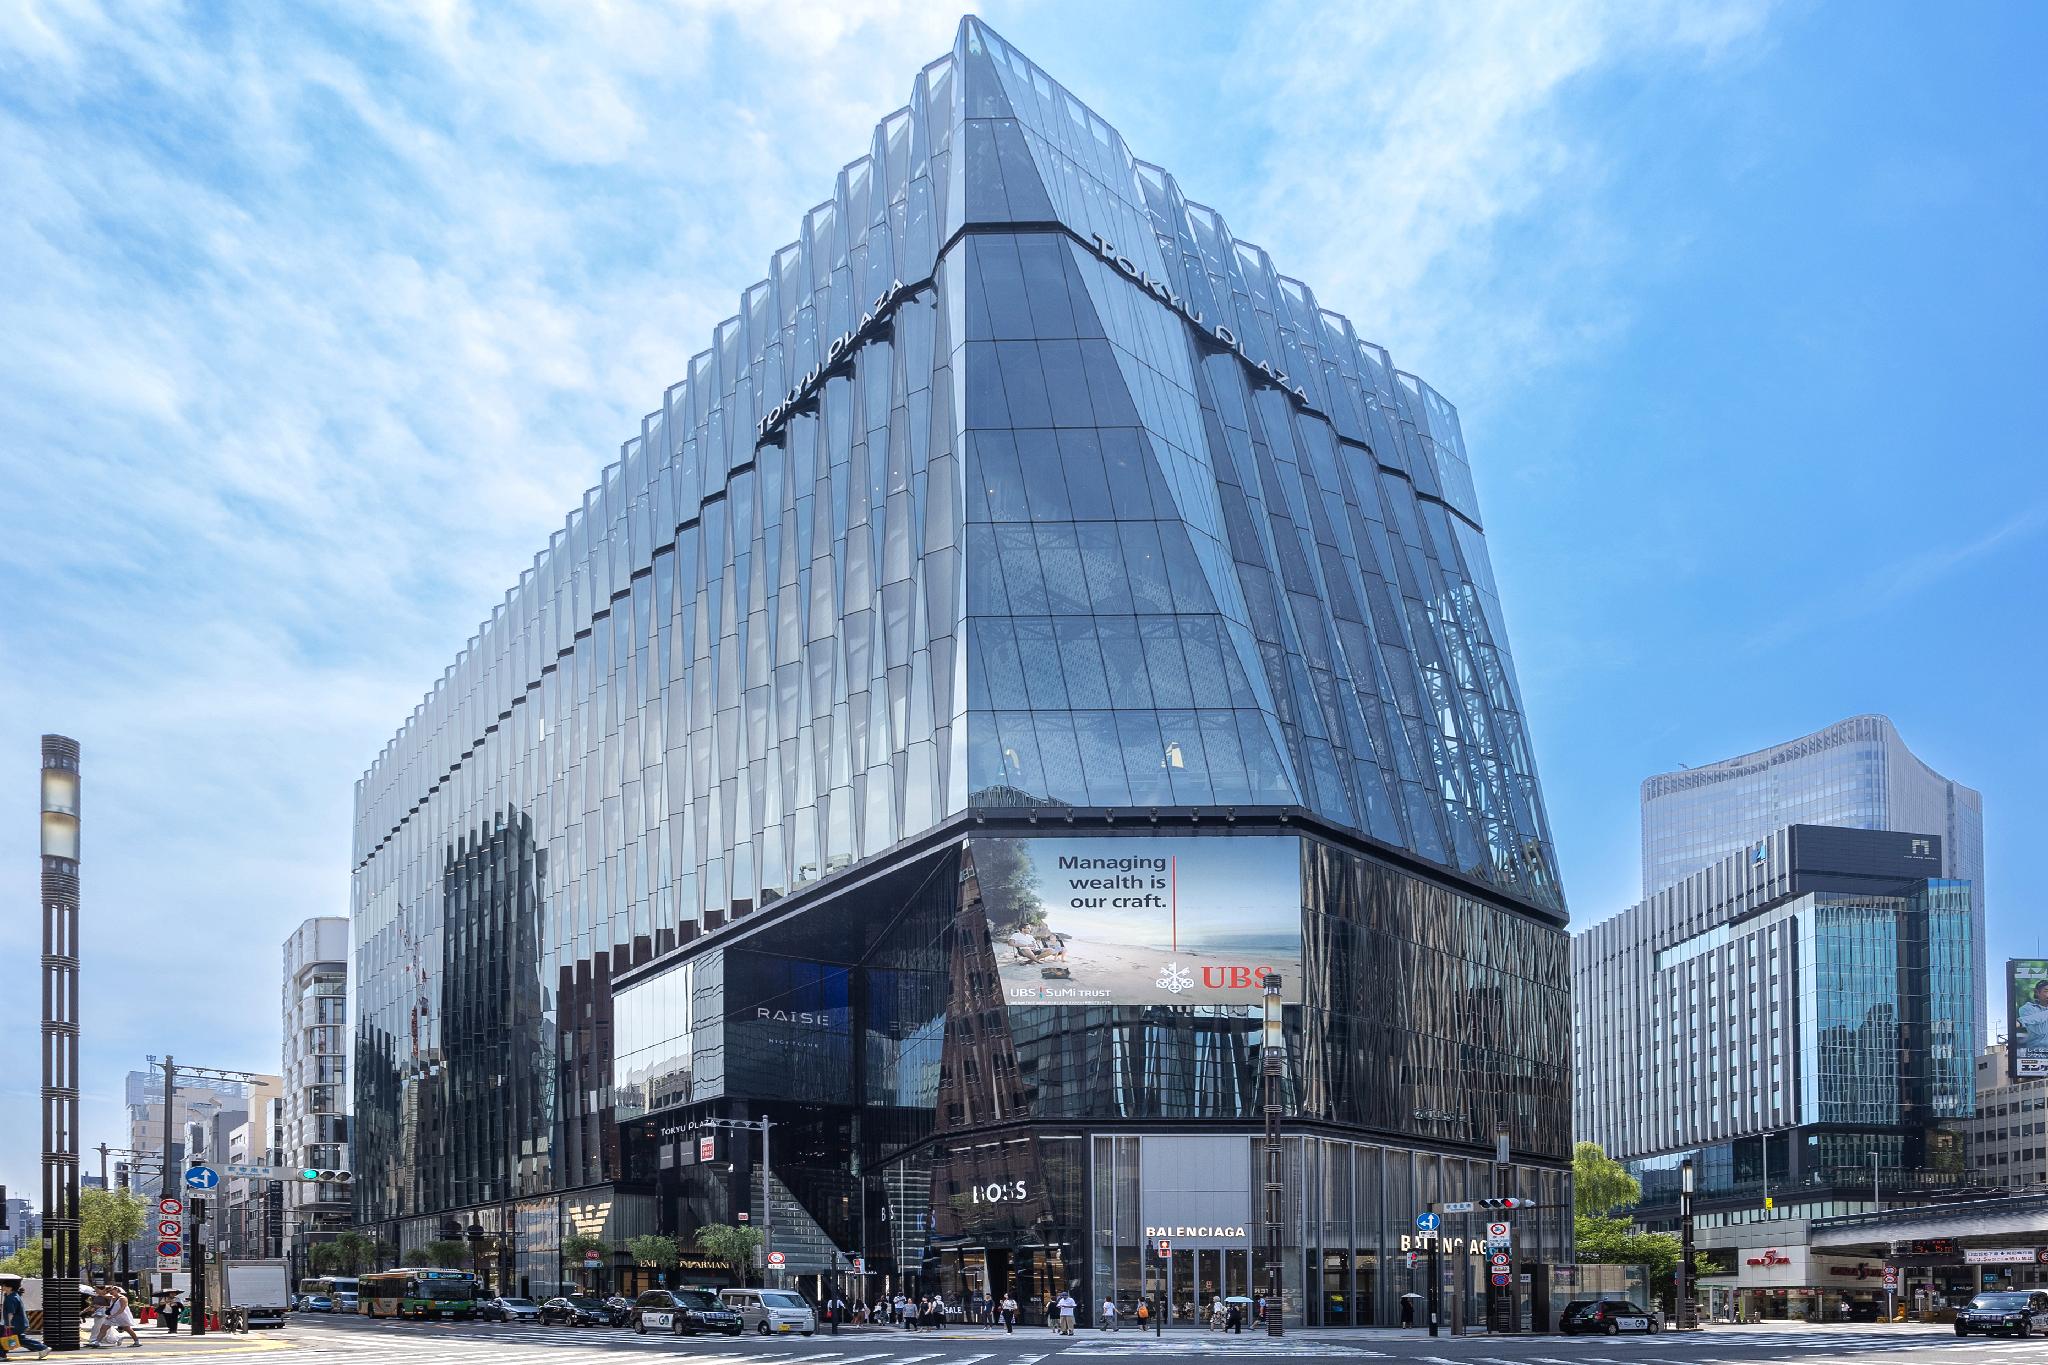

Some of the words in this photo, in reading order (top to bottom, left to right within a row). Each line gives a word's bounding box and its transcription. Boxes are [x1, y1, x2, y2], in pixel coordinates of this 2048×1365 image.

[1092, 232, 1203, 324] TOKYU
[1215, 325, 1309, 405] PLAZA
[757, 362, 822, 435] TOKYU
[828, 279, 904, 365] PLAZA
[1058, 855, 1166, 872] Managing
[1069, 874, 1144, 890] wealth
[1150, 875, 1166, 889] is
[1070, 896, 1107, 909] our
[1112, 893, 1167, 909] craft.
[1200, 965, 1274, 990] UBS
[1010, 988, 1036, 997] UBS
[1078, 989, 1111, 997] TRUST
[757, 1007, 829, 1026] RAISE
[661, 1124, 686, 1136] TOKYU
[1146, 1226, 1246, 1237] BALENCIAGA
[694, 1260, 729, 1269] ARMANI
[944, 1306, 963, 1314] SALE
